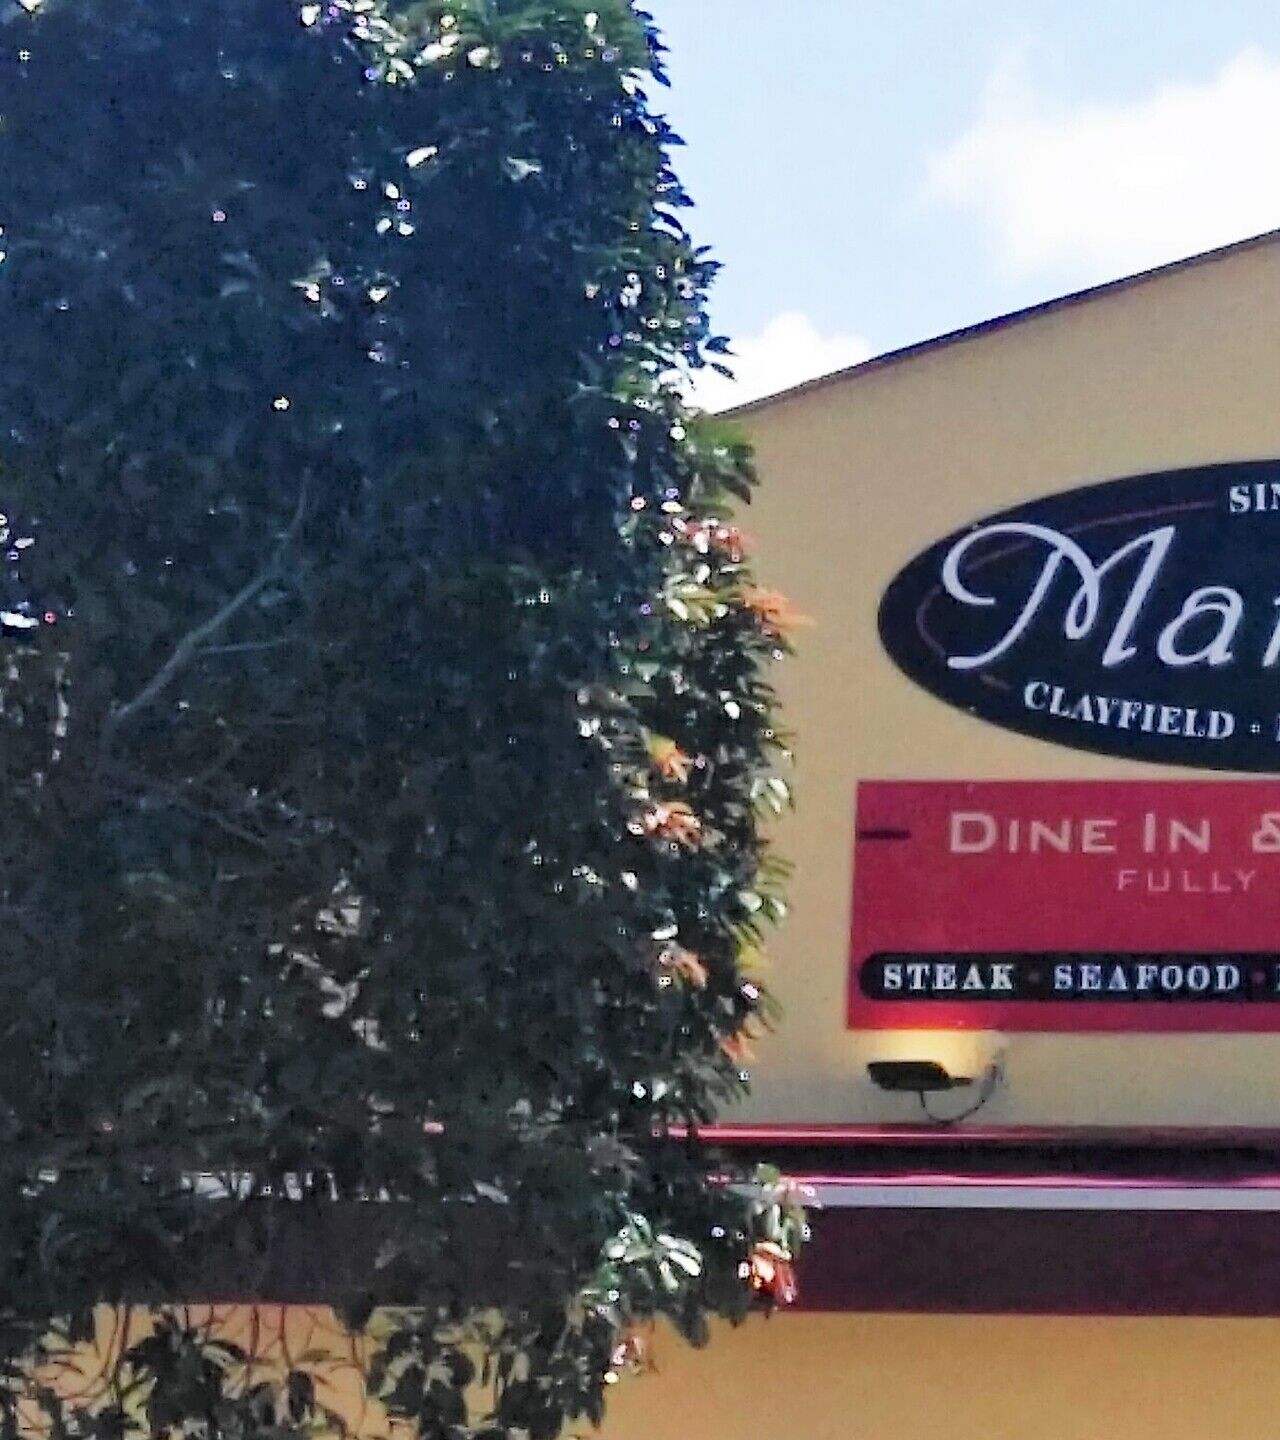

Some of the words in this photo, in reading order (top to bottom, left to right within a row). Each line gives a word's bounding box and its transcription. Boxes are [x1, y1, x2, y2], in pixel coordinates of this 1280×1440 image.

[1023, 680, 1234, 741] CLAYFIELD
[950, 811, 1117, 855] DINE
[1144, 811, 1211, 854] IN
[1118, 869, 1256, 894] FULLY
[883, 962, 1015, 990] STEAK
[1054, 963, 1242, 991] SEAFOOD
